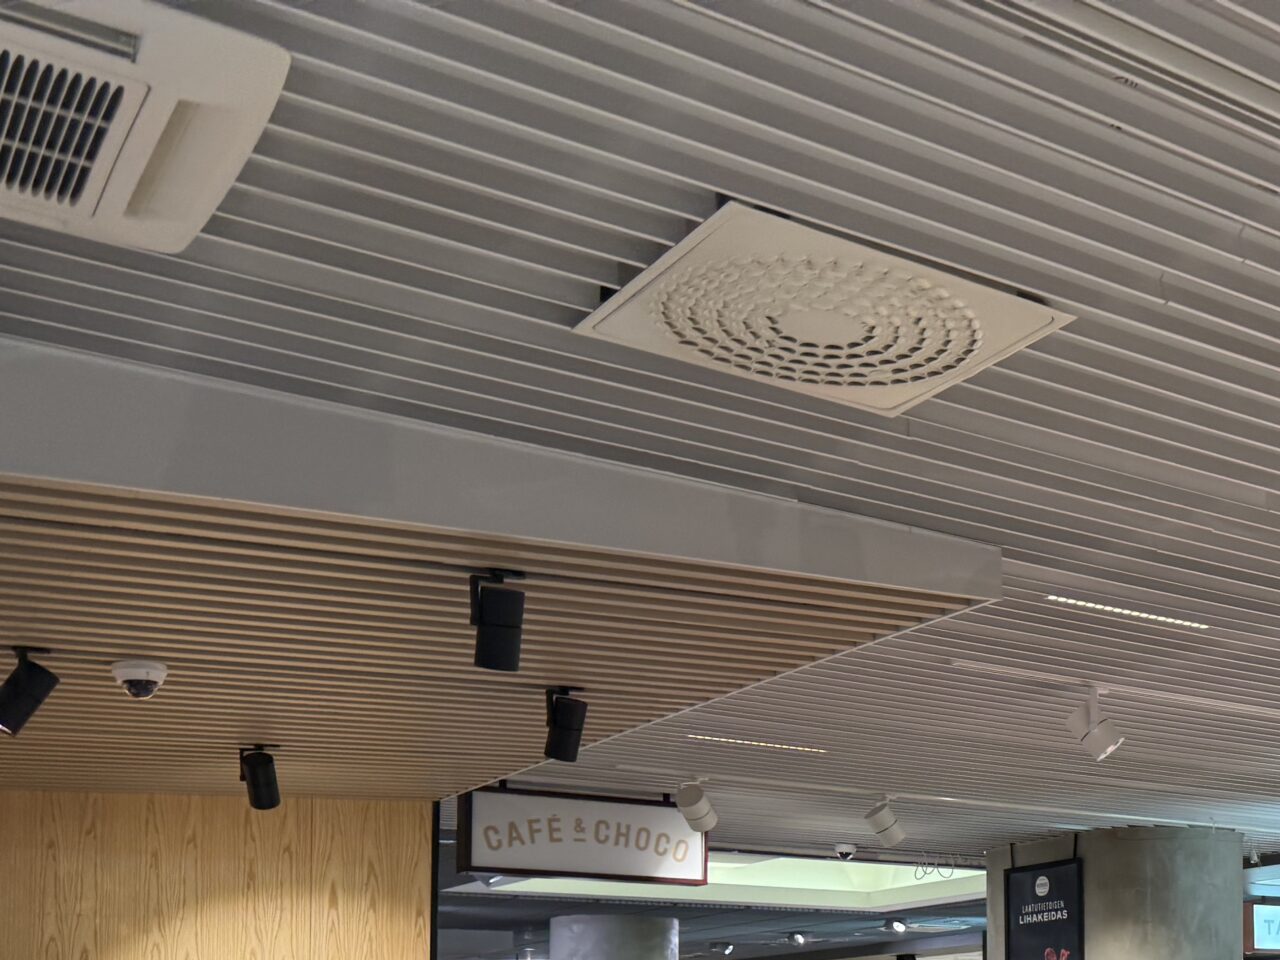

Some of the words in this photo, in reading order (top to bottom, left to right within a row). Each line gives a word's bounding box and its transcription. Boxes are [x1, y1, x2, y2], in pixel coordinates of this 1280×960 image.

[483, 814, 563, 852] CAFÉ
[573, 817, 587, 842] &
[594, 820, 690, 863] CHOCO
[1019, 910, 1068, 925] LIHAKEIDAS
